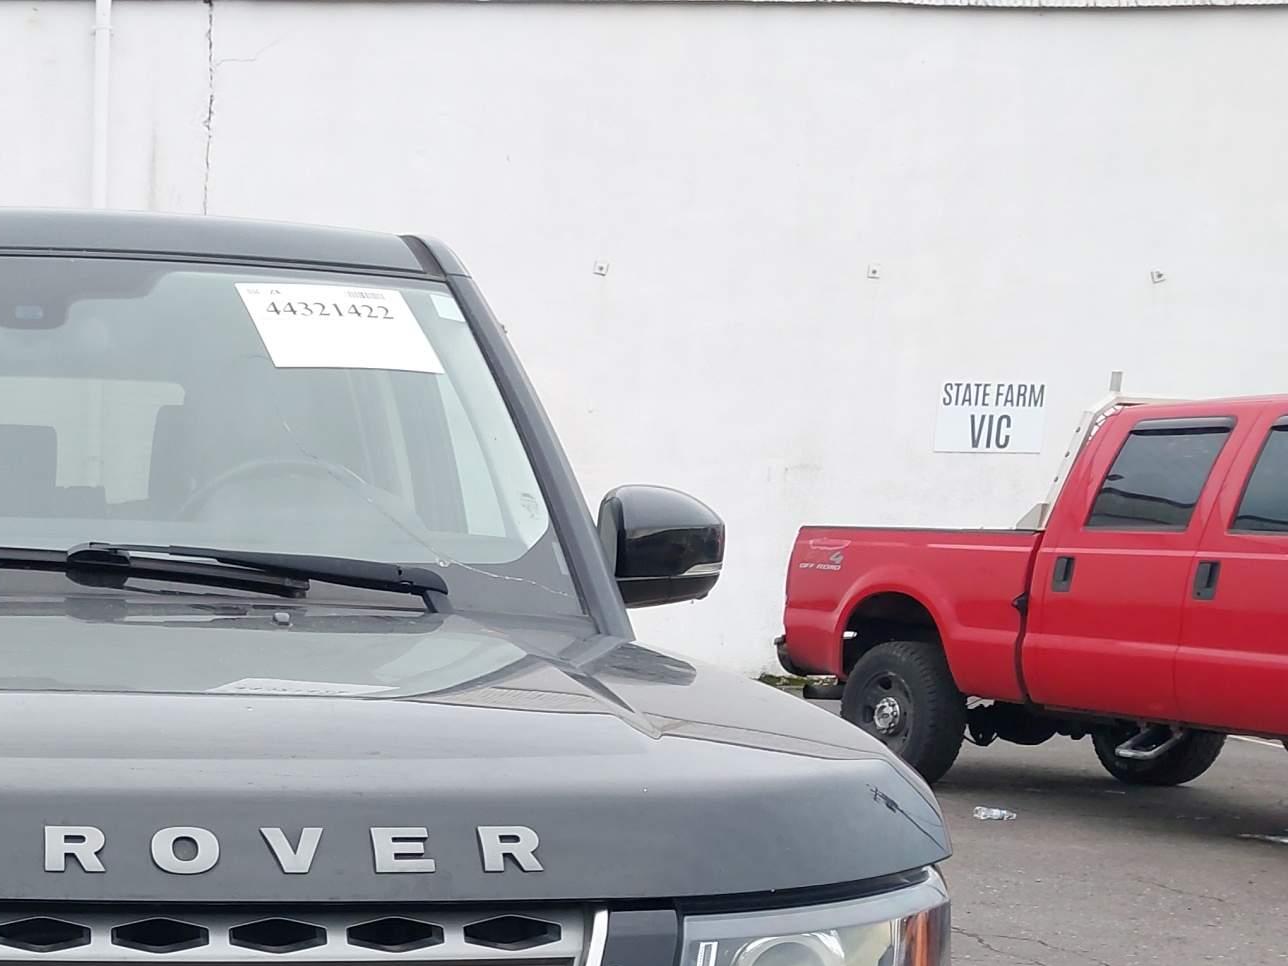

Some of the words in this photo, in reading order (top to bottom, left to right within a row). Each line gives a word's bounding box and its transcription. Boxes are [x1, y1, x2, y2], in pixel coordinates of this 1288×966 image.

[266, 301, 395, 320] 44321422
[942, 382, 992, 407] STATE
[994, 383, 1046, 408] FARM
[969, 413, 1012, 449] VIC
[44, 824, 545, 875] ROVER
